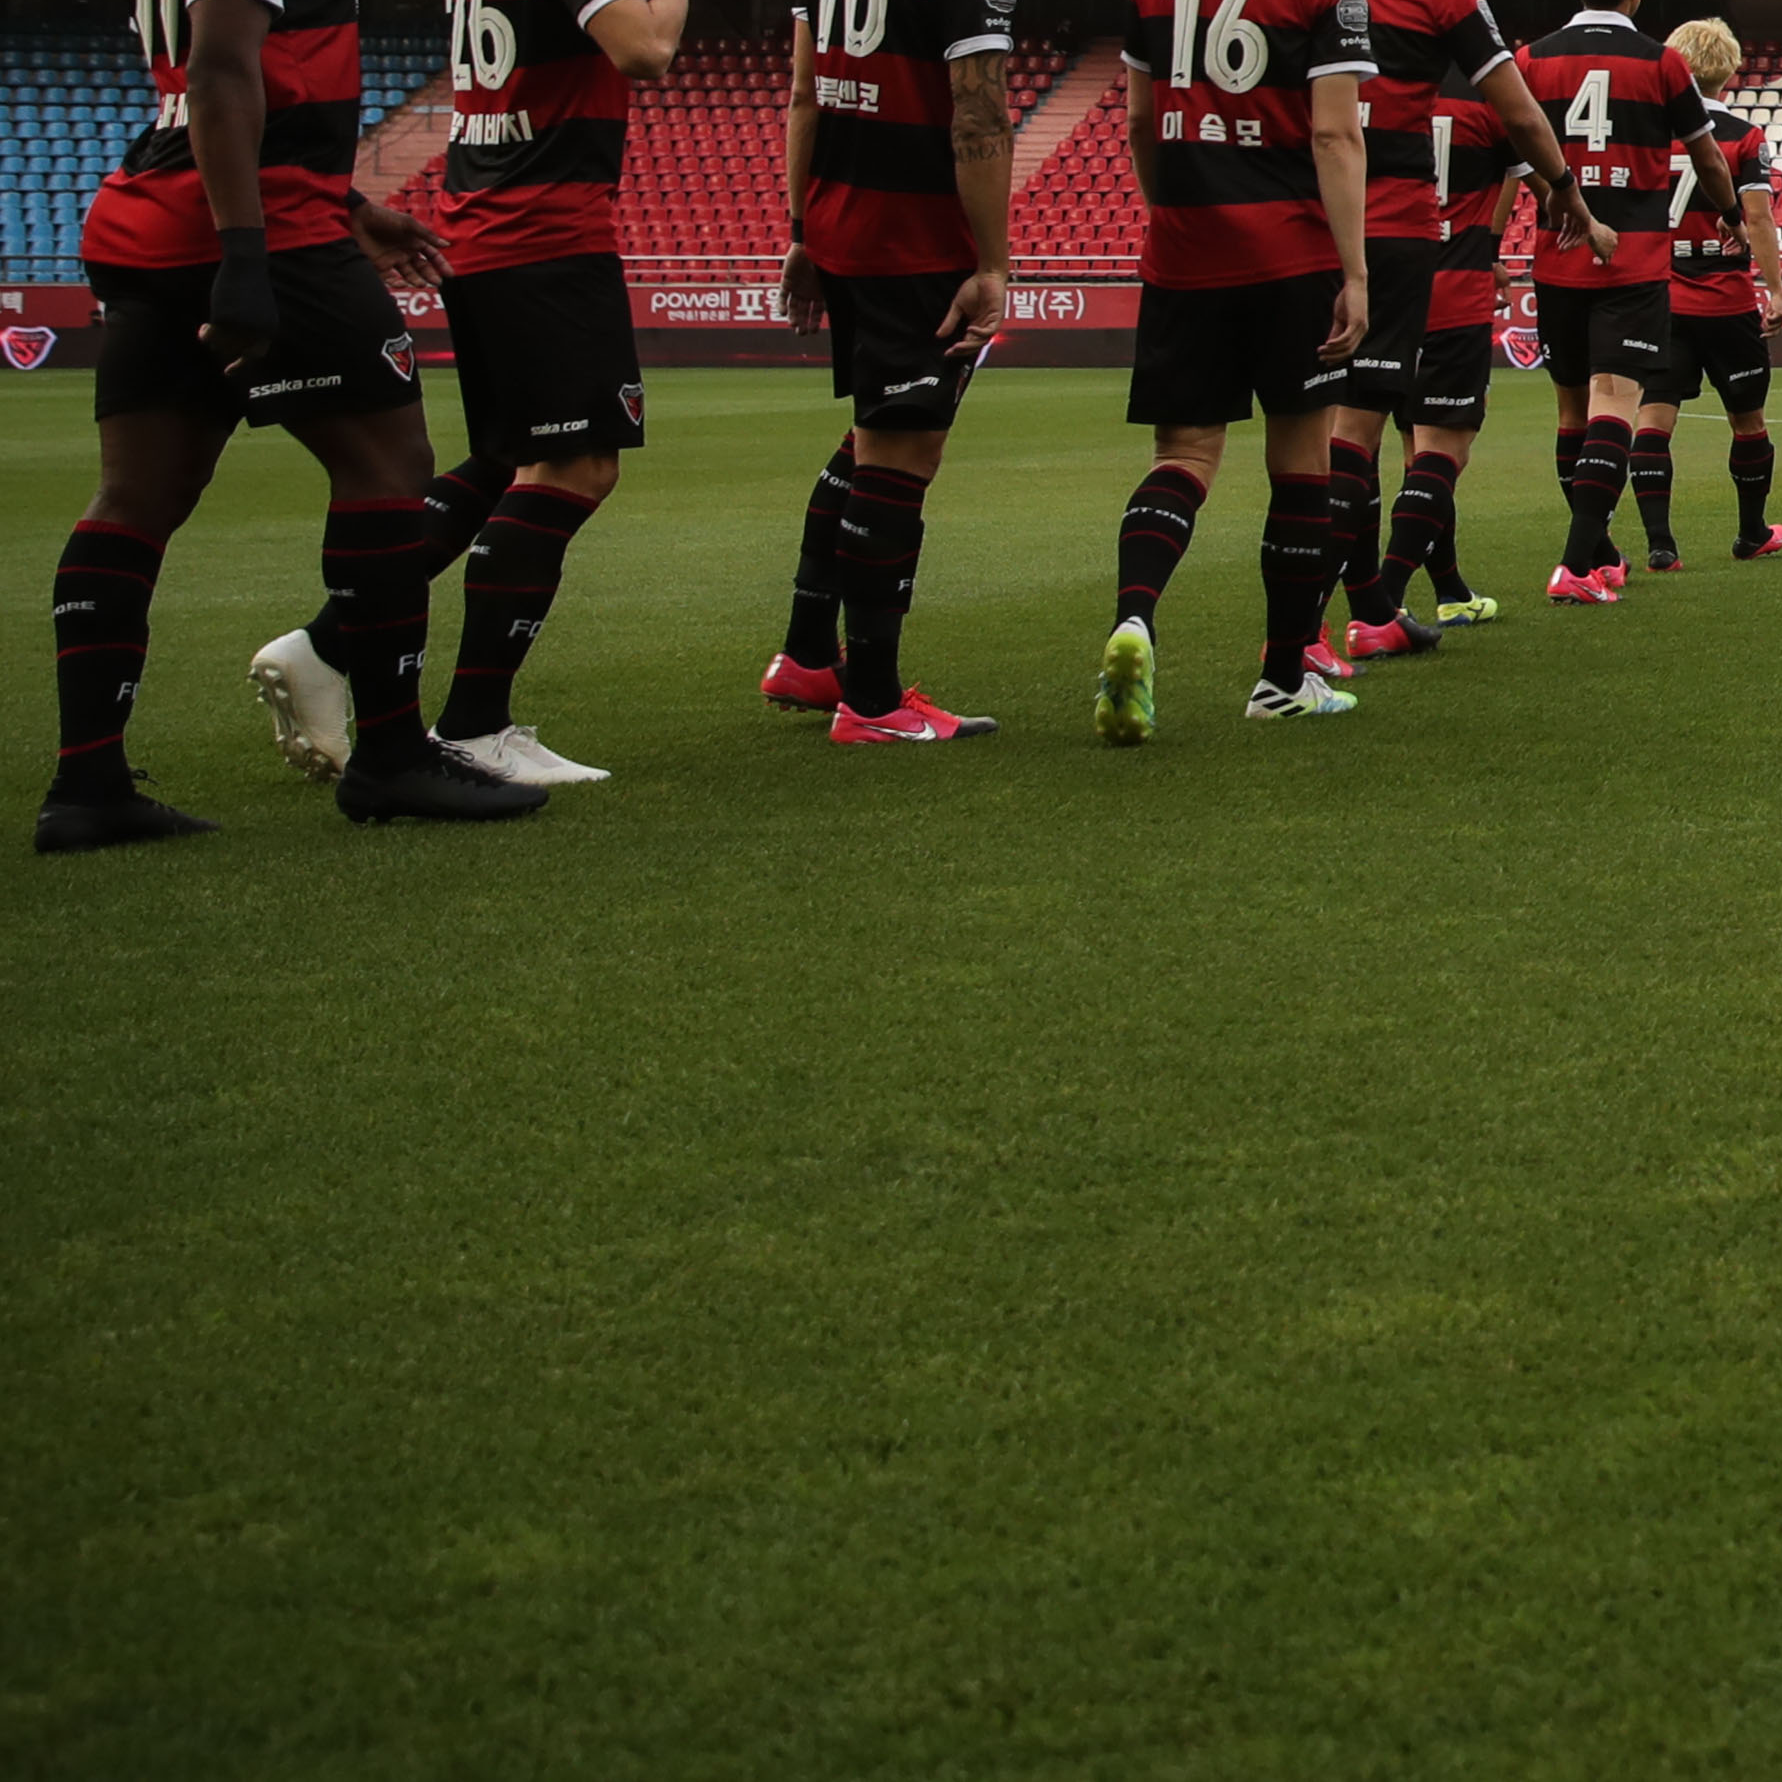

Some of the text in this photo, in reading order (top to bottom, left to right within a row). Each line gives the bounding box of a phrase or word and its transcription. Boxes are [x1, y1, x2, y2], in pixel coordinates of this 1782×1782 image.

[1565, 69, 1613, 152] 4
[1162, 111, 1262, 148] 이승모
[1570, 165, 1630, 188] 민광
[1669, 154, 1698, 229] 7
[651, 290, 730, 313] powell
[1003, 289, 1085, 320] 발(주)
[249, 373, 342, 399] ssaka.com
